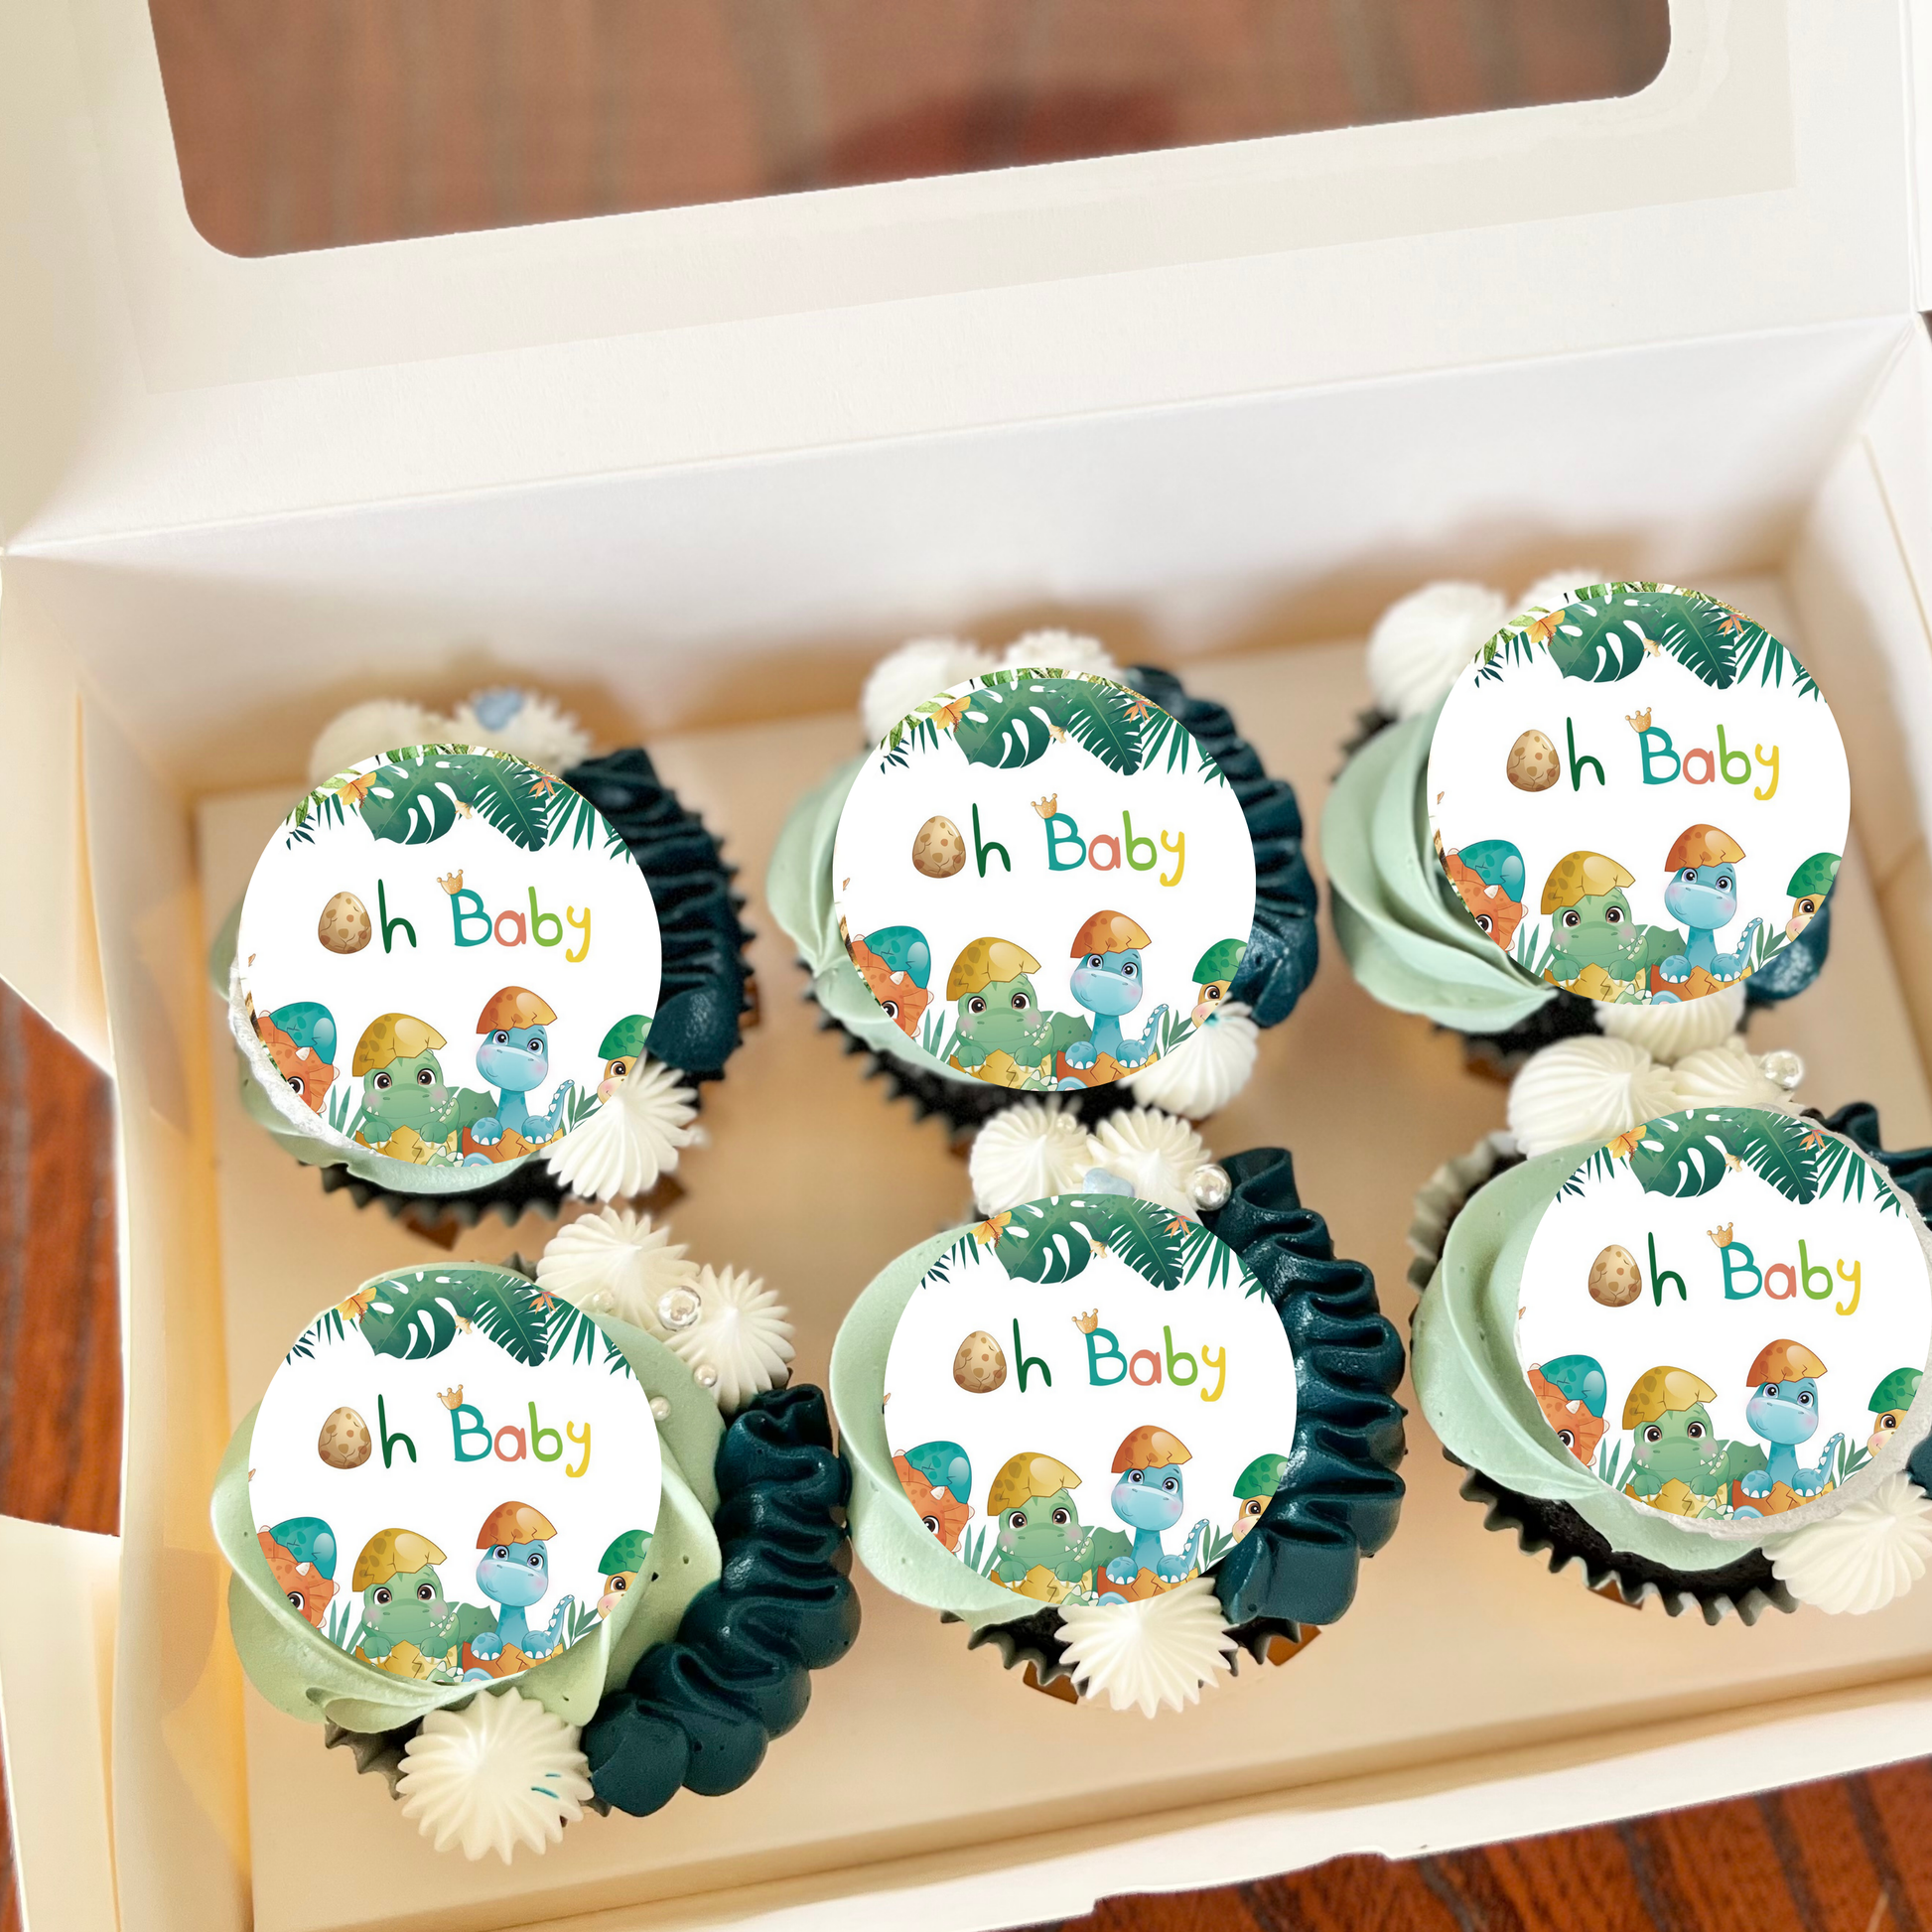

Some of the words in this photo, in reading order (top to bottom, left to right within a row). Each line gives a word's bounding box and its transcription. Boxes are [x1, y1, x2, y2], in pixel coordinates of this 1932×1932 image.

[1640, 724, 1779, 801] Baby
[1046, 810, 1185, 887] Baby
[452, 886, 591, 963] Baby
[1723, 1239, 1862, 1315] Baby
[1087, 1325, 1226, 1402] Baby
[452, 1401, 591, 1478] Baby
